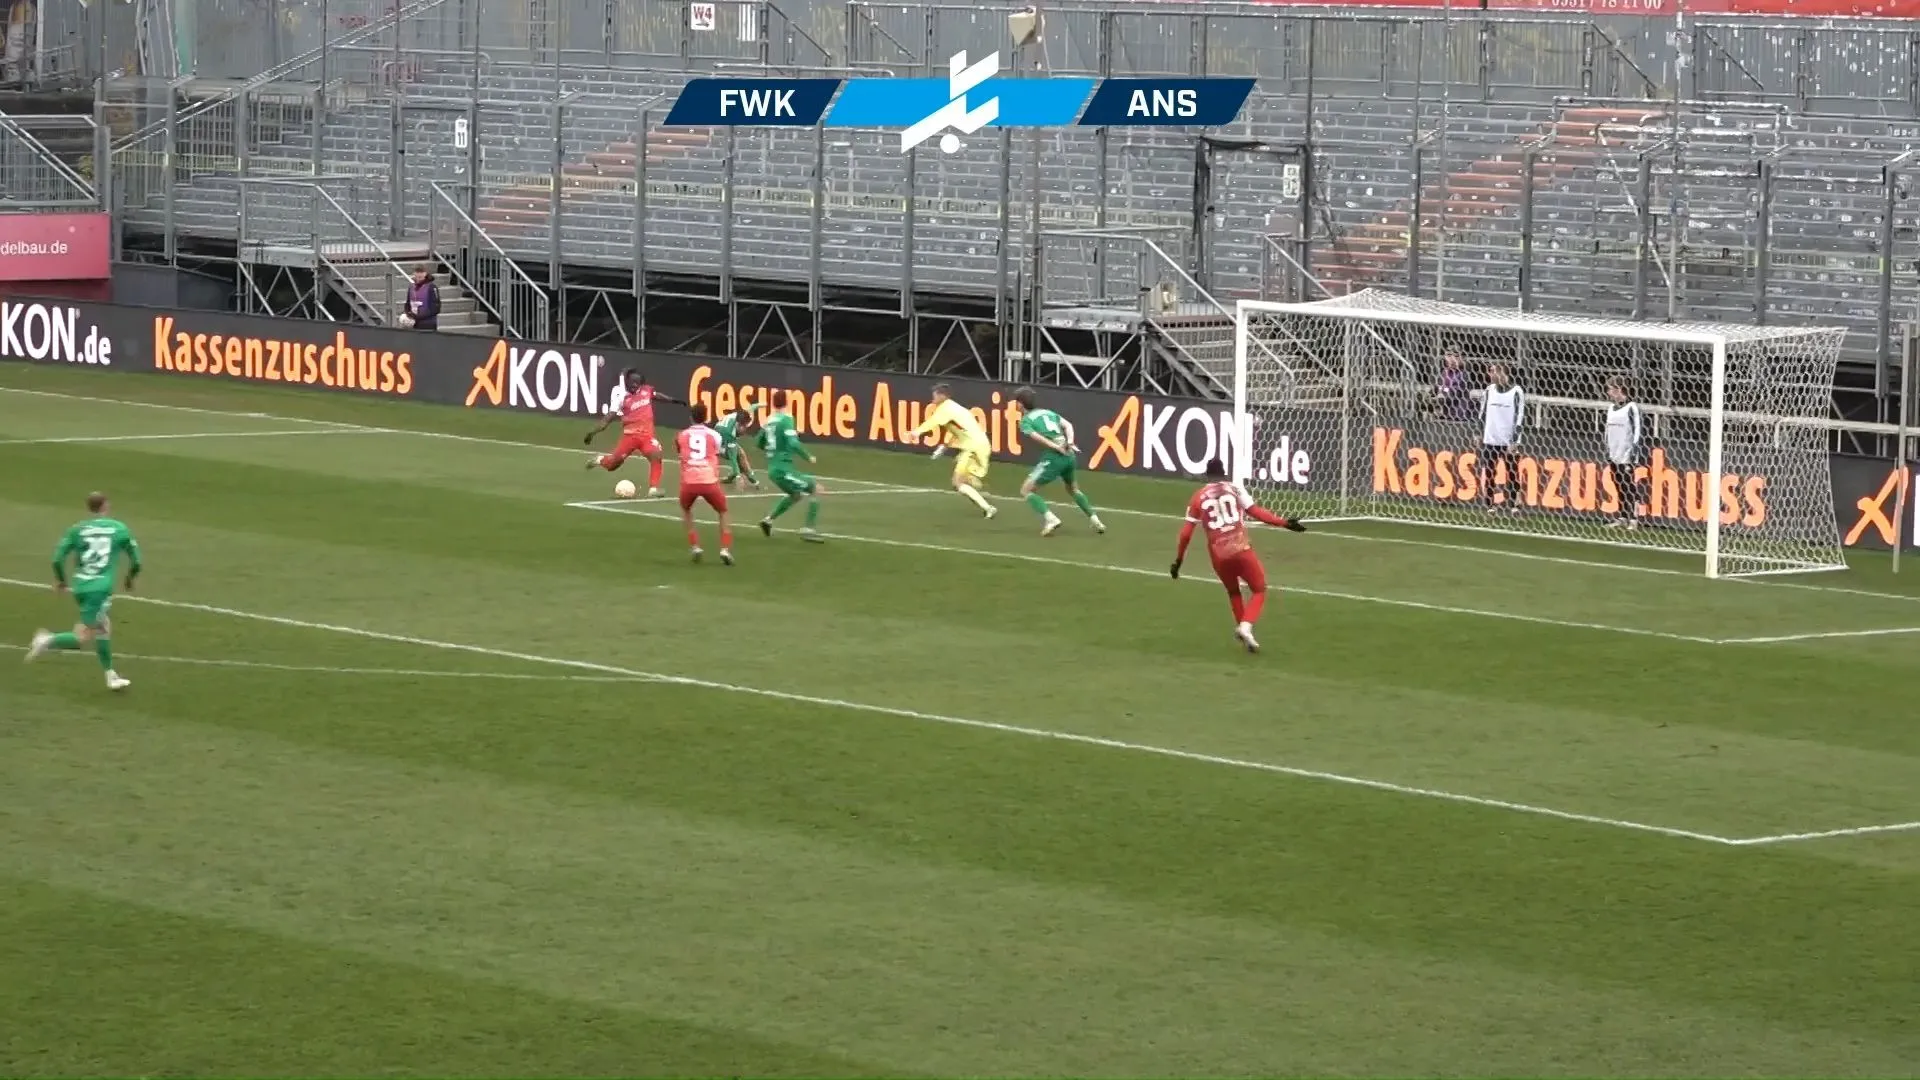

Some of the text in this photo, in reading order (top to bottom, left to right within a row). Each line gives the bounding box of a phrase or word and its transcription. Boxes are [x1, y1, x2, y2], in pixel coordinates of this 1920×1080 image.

[693, 6, 713, 20] W4
[154, 316, 413, 395] Kassenzuschuss
[689, 365, 857, 439] Gesunde
[689, 433, 707, 460] 9
[1088, 395, 1311, 484] AKON.de
[1201, 494, 1239, 530] 30
